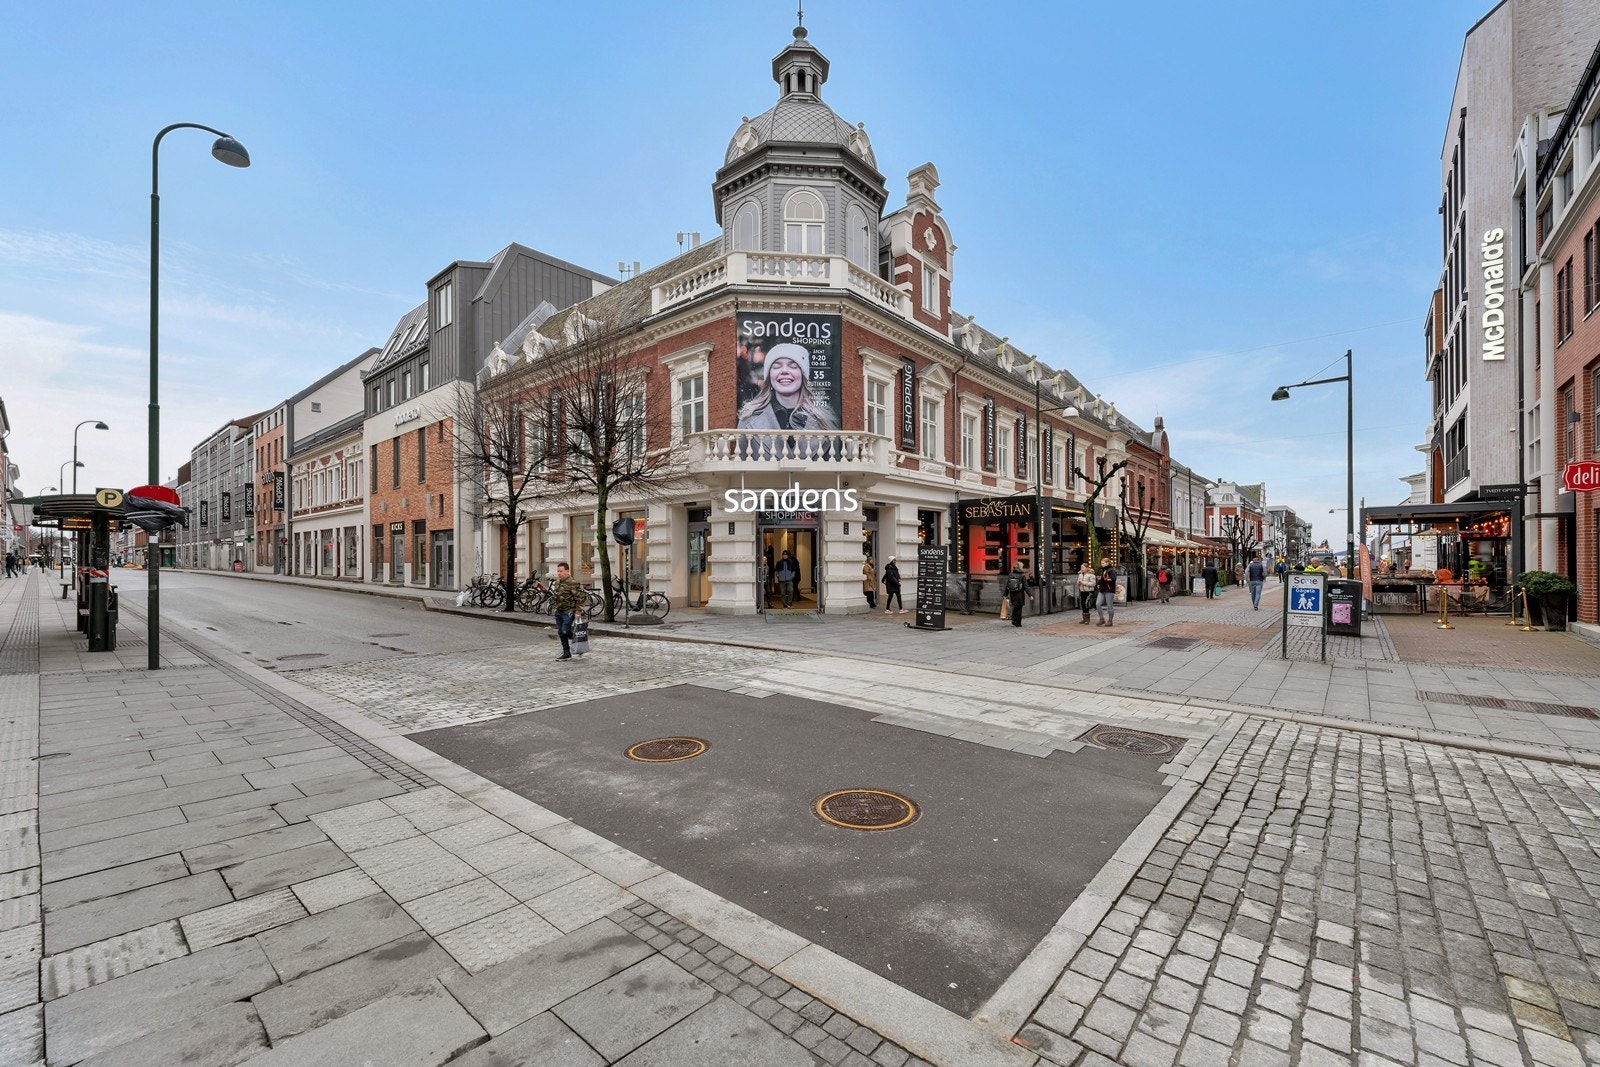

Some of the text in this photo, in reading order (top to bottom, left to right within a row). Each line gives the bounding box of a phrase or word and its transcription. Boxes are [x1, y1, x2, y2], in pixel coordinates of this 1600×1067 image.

[1482, 228, 1505, 361] McDonald's
[743, 318, 831, 339] sandens
[792, 337, 831, 346] SHOPPING
[813, 371, 825, 379] 35
[904, 364, 913, 433] SHOPPING
[1573, 467, 1600, 485] deli
[275, 476, 283, 504] SHOPPING
[724, 482, 859, 513] sandens
[765, 511, 812, 520] SHOPPING
[391, 523, 403, 531] KICKS
